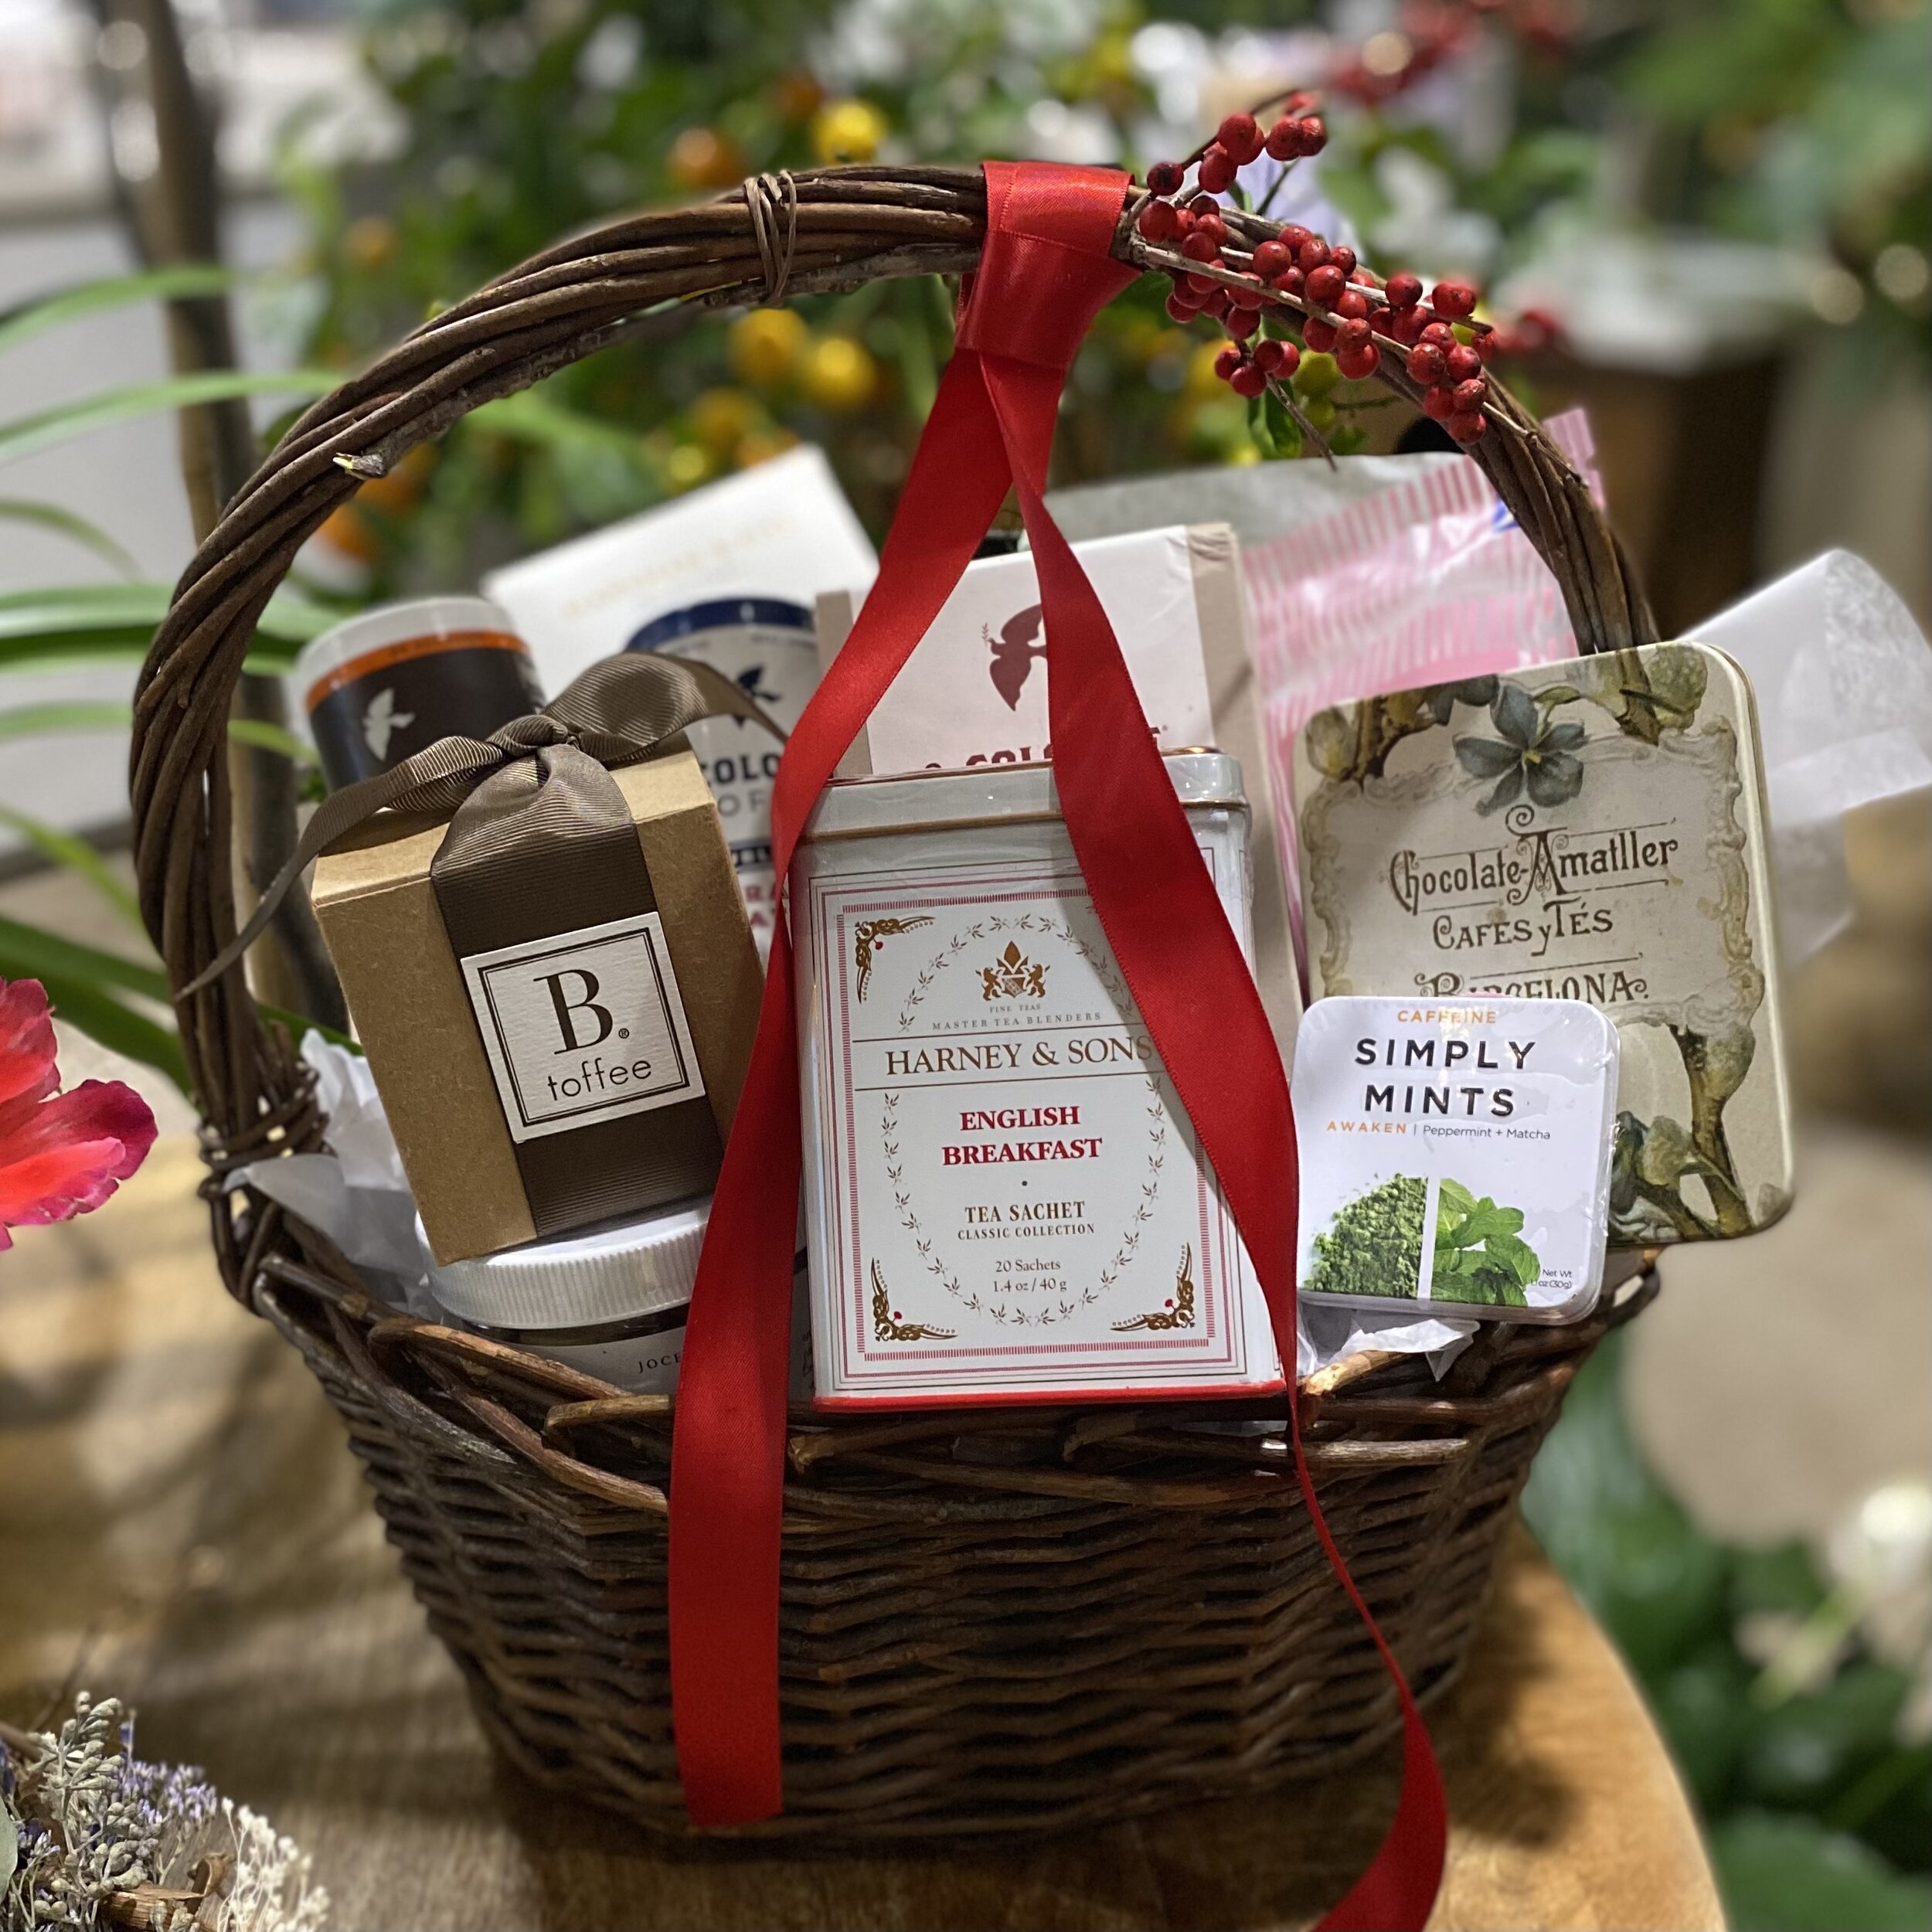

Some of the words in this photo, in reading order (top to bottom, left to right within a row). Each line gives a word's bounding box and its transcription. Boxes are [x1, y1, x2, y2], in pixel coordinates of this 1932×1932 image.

[932, 1019, 988, 1031] MASTER
[995, 1017, 1019, 1026] TEA
[1027, 1012, 1101, 1026] BLENDERS
[1397, 1009, 1497, 1024] CAFFEINE
[885, 1043, 1023, 1076] HARNEY
[1032, 1041, 1060, 1066] &
[1068, 1036, 1152, 1065] SONS
[1355, 1038, 1536, 1070] SIMPLY
[547, 1057, 651, 1101] toffee
[1364, 1084, 1515, 1117] MINTS
[960, 1106, 1080, 1131] ENGLISH
[1327, 1121, 1407, 1134] AWAKEN
[1423, 1125, 1492, 1138] Peppermint
[1507, 1128, 1551, 1140] Matcha
[942, 1138, 1103, 1166] BREAKFAST
[964, 1206, 1002, 1223] TEA
[1009, 1200, 1085, 1221] SACHET
[957, 1226, 1011, 1240] CLASSIC
[1015, 1223, 1094, 1236] COLLECTION
[995, 1260, 1012, 1272] 20
[1015, 1258, 1061, 1272] Sachets
[1543, 1269, 1556, 1277] Net
[994, 1280, 1012, 1292] 1.4
[1015, 1283, 1029, 1291] oz
[1040, 1277, 1056, 1291] 40
[1060, 1281, 1067, 1292] g
